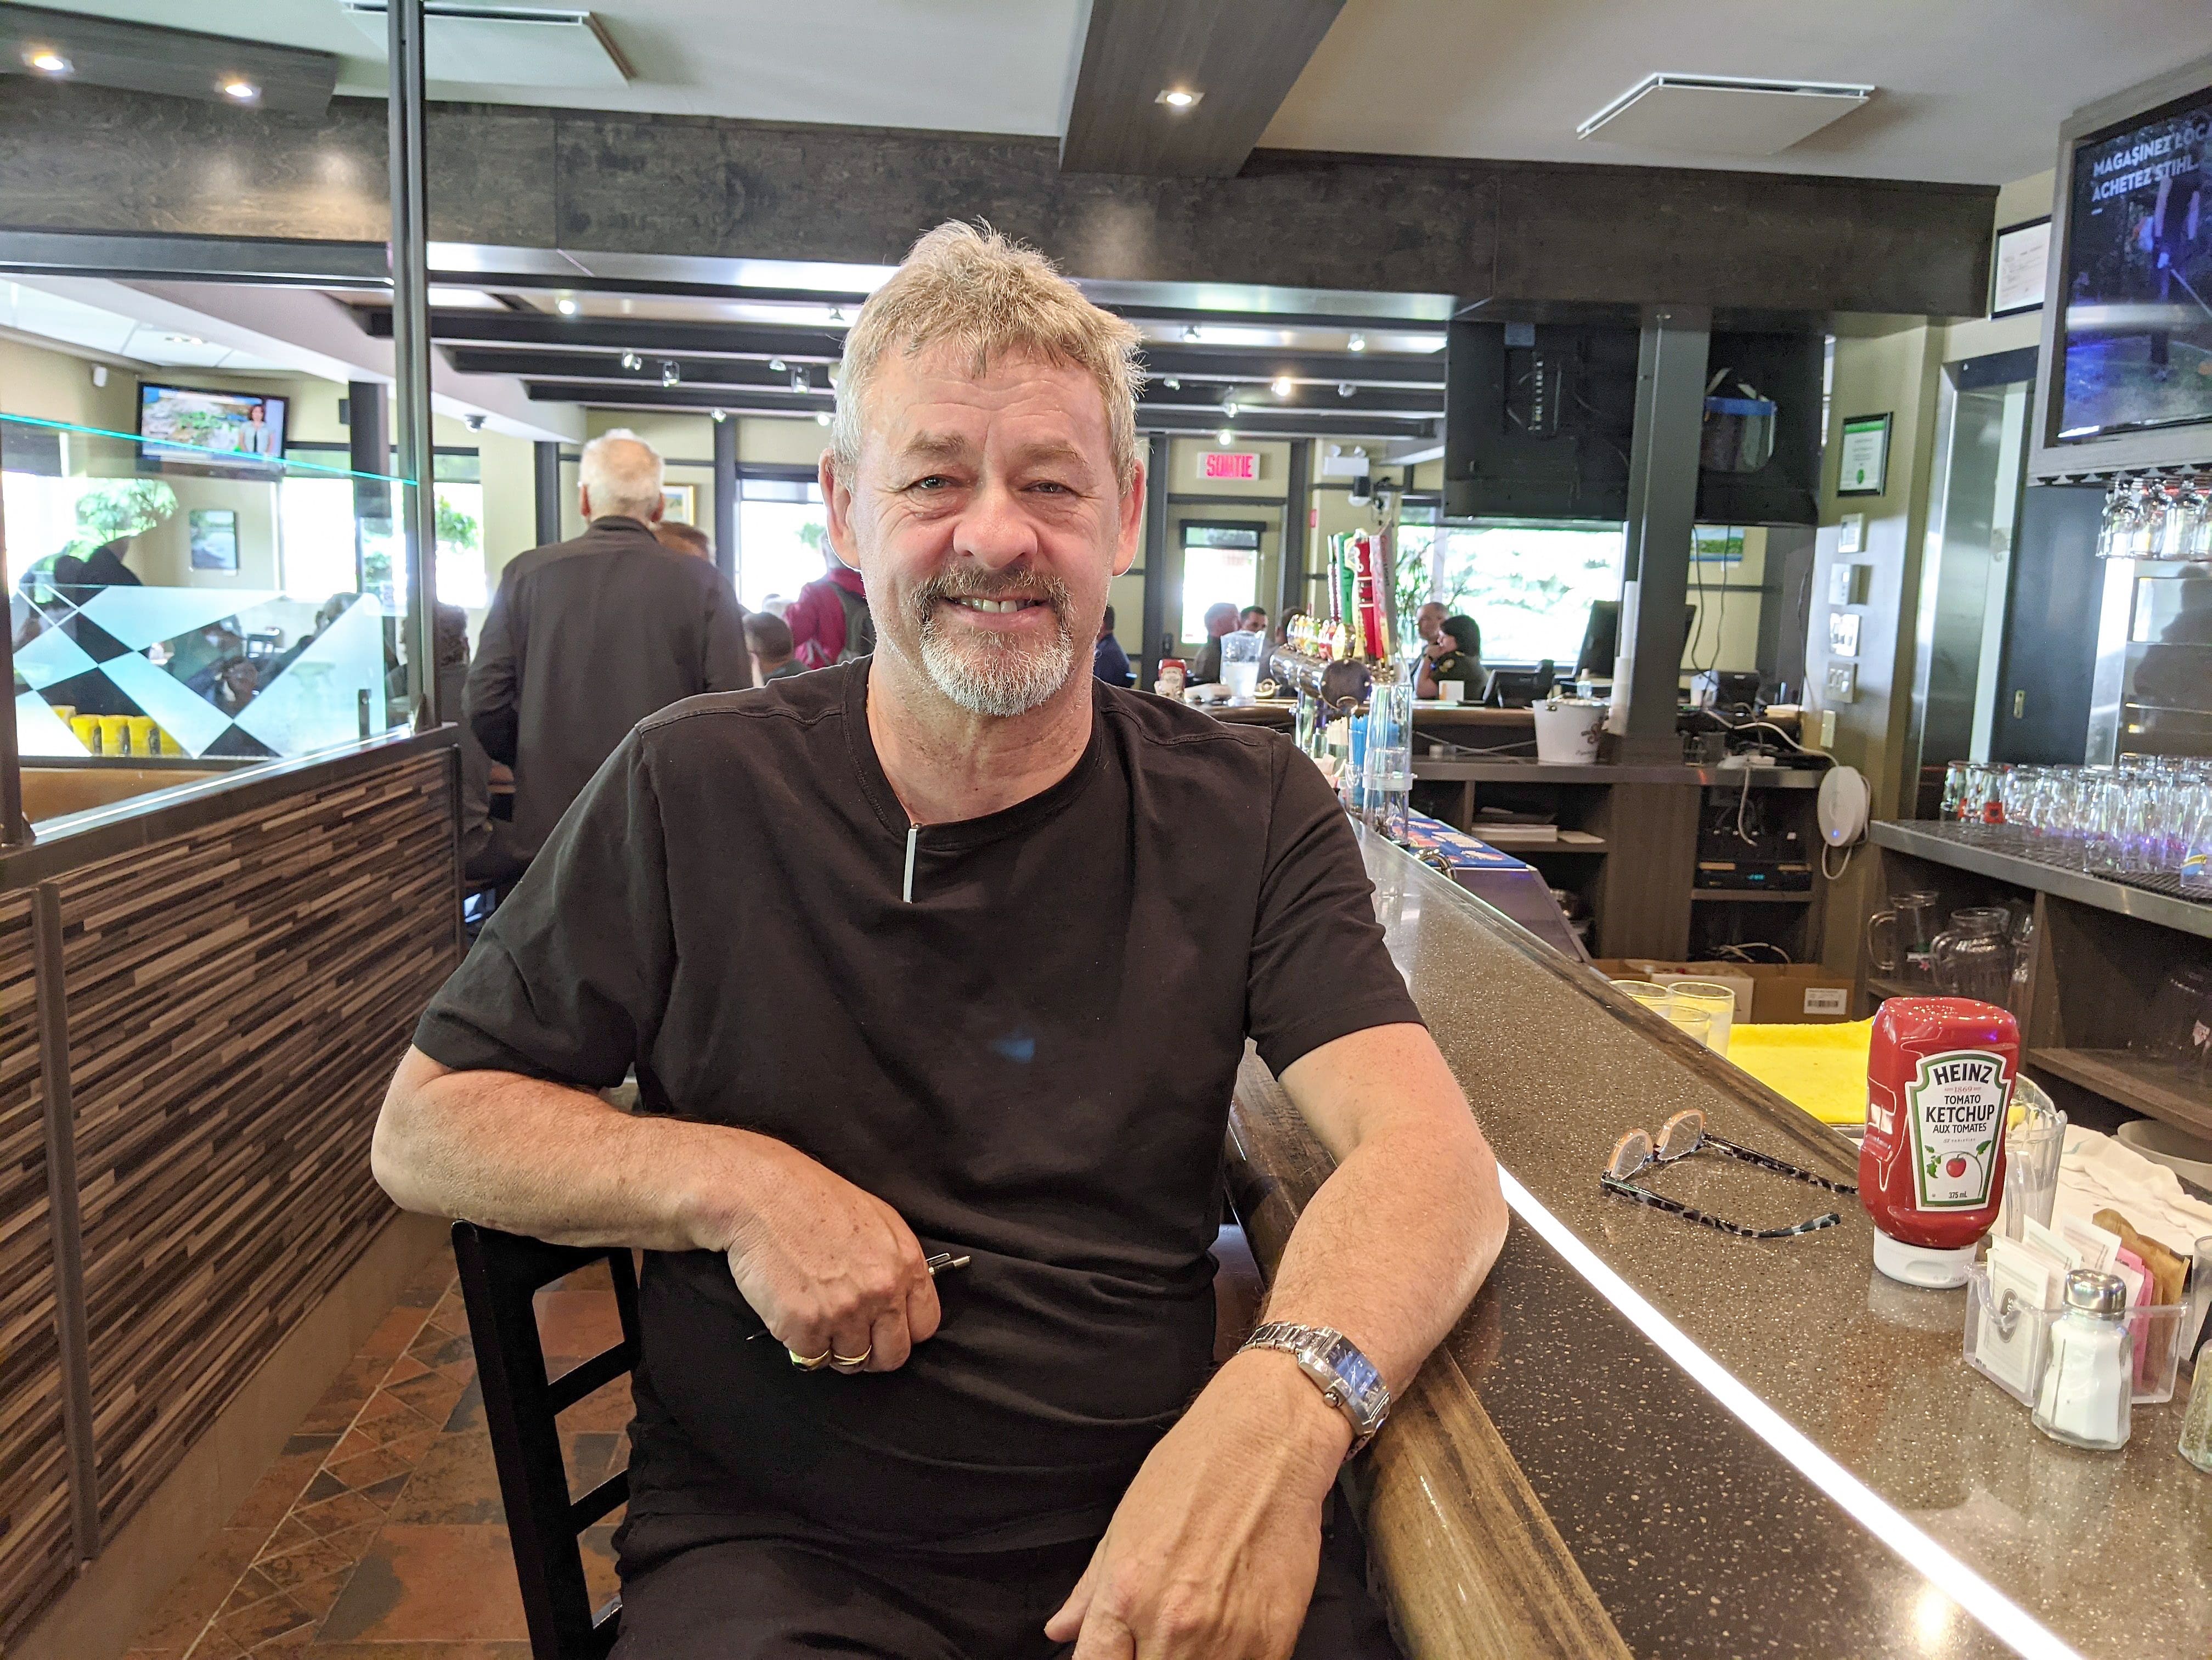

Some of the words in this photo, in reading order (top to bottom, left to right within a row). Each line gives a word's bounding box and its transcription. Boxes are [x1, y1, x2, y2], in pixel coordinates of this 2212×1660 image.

[2094, 136, 2172, 177] MAGASINEZ
[2091, 166, 2152, 202] ACHETEZ
[1933, 1063, 1993, 1085] HEINZ
[1944, 1094, 1981, 1105] TOMATO
[1926, 1104, 1995, 1123] KETCHUP
[1933, 1124, 1950, 1134] AUX
[1952, 1122, 1987, 1133] TOMATES
